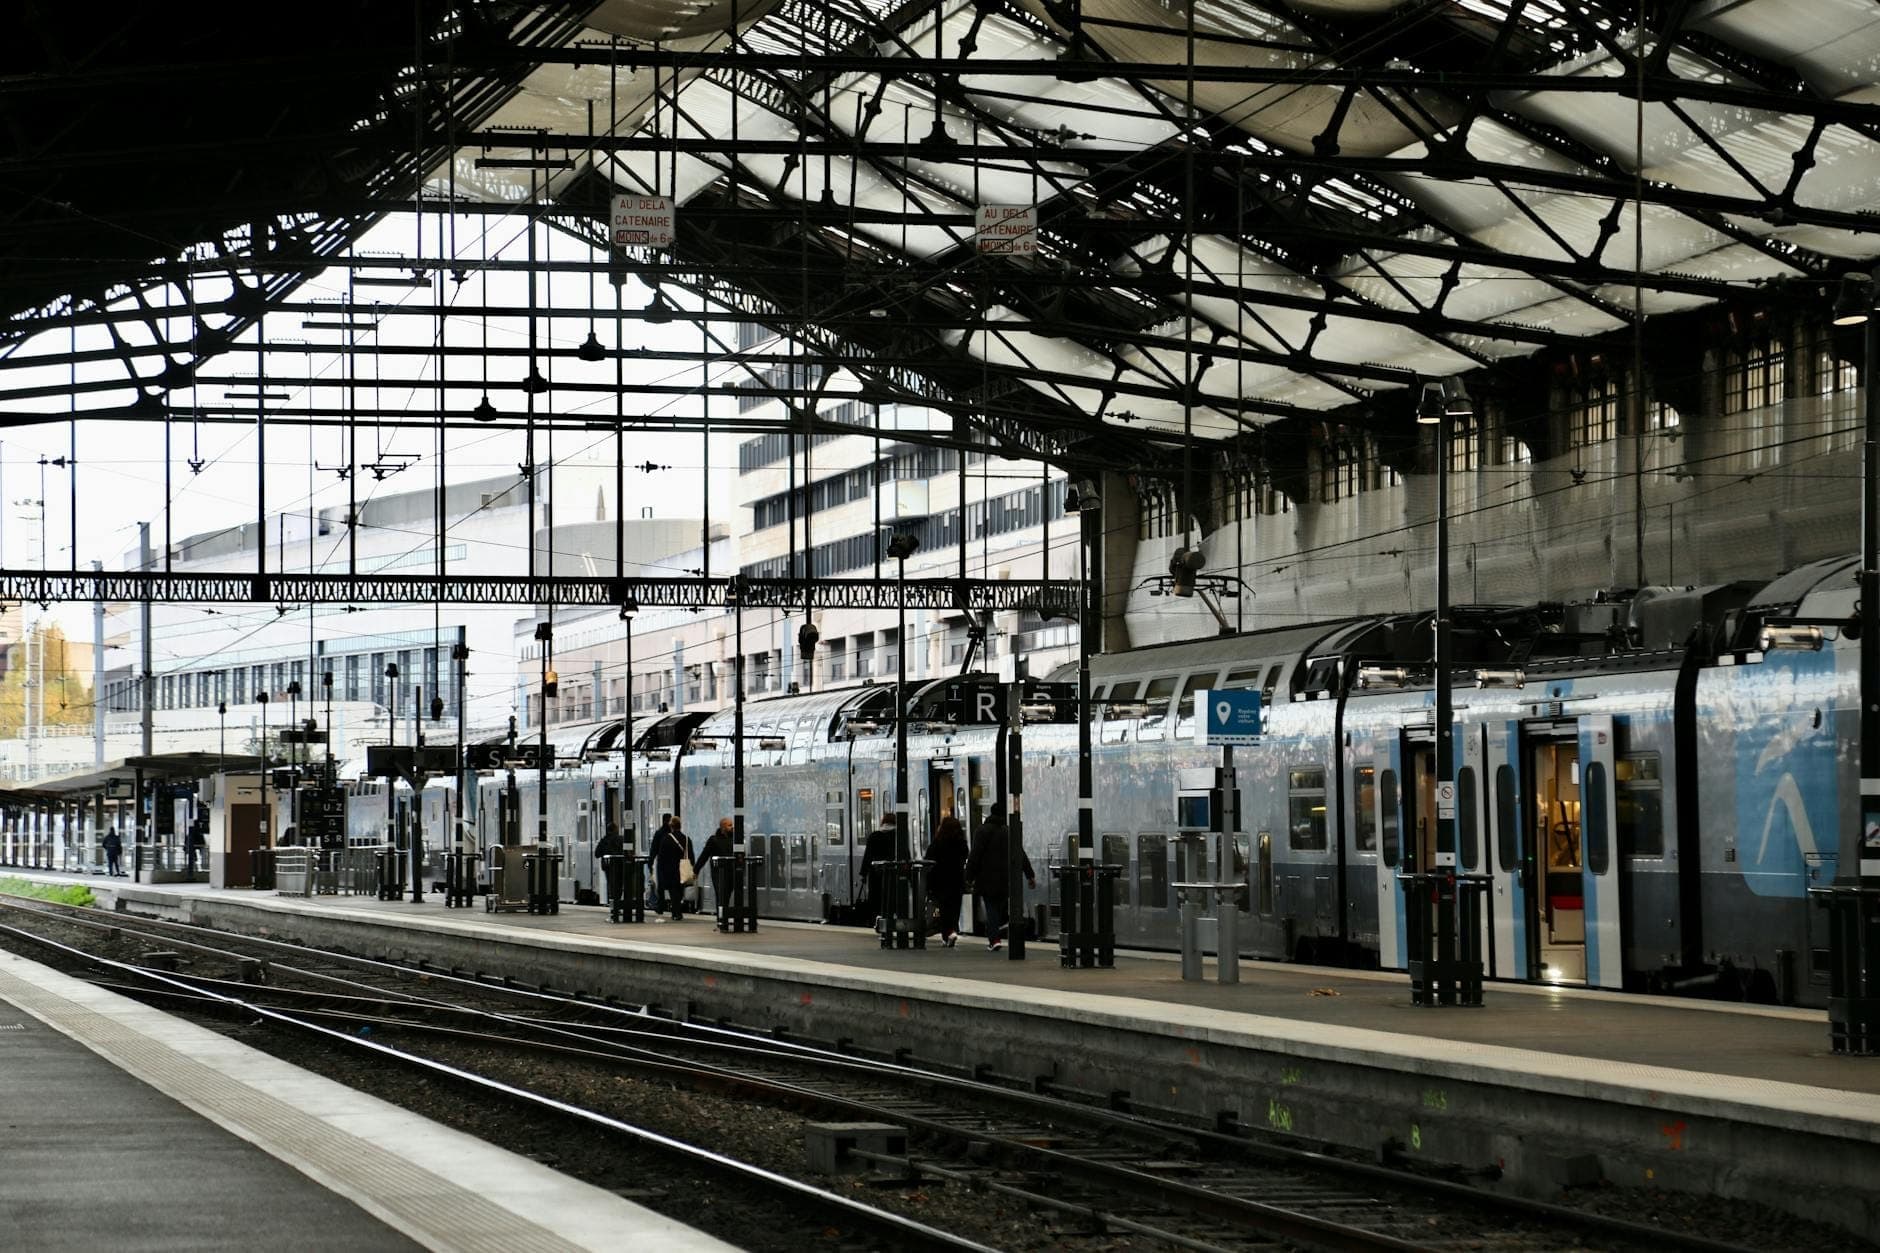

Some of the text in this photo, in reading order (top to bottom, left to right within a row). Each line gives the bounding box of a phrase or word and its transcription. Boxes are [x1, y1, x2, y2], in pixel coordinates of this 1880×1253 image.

[620, 199, 665, 210] AU DELA
[985, 208, 1029, 219] AU DELA
[615, 215, 671, 227] CATENAIRE
[980, 224, 1033, 235] CATENAIRE
[618, 231, 647, 242] MOINS
[984, 240, 1011, 251] MOINS
[976, 691, 999, 722] R
[489, 750, 501, 769] S
[323, 803, 343, 812] U Z
[336, 835, 343, 843] R
